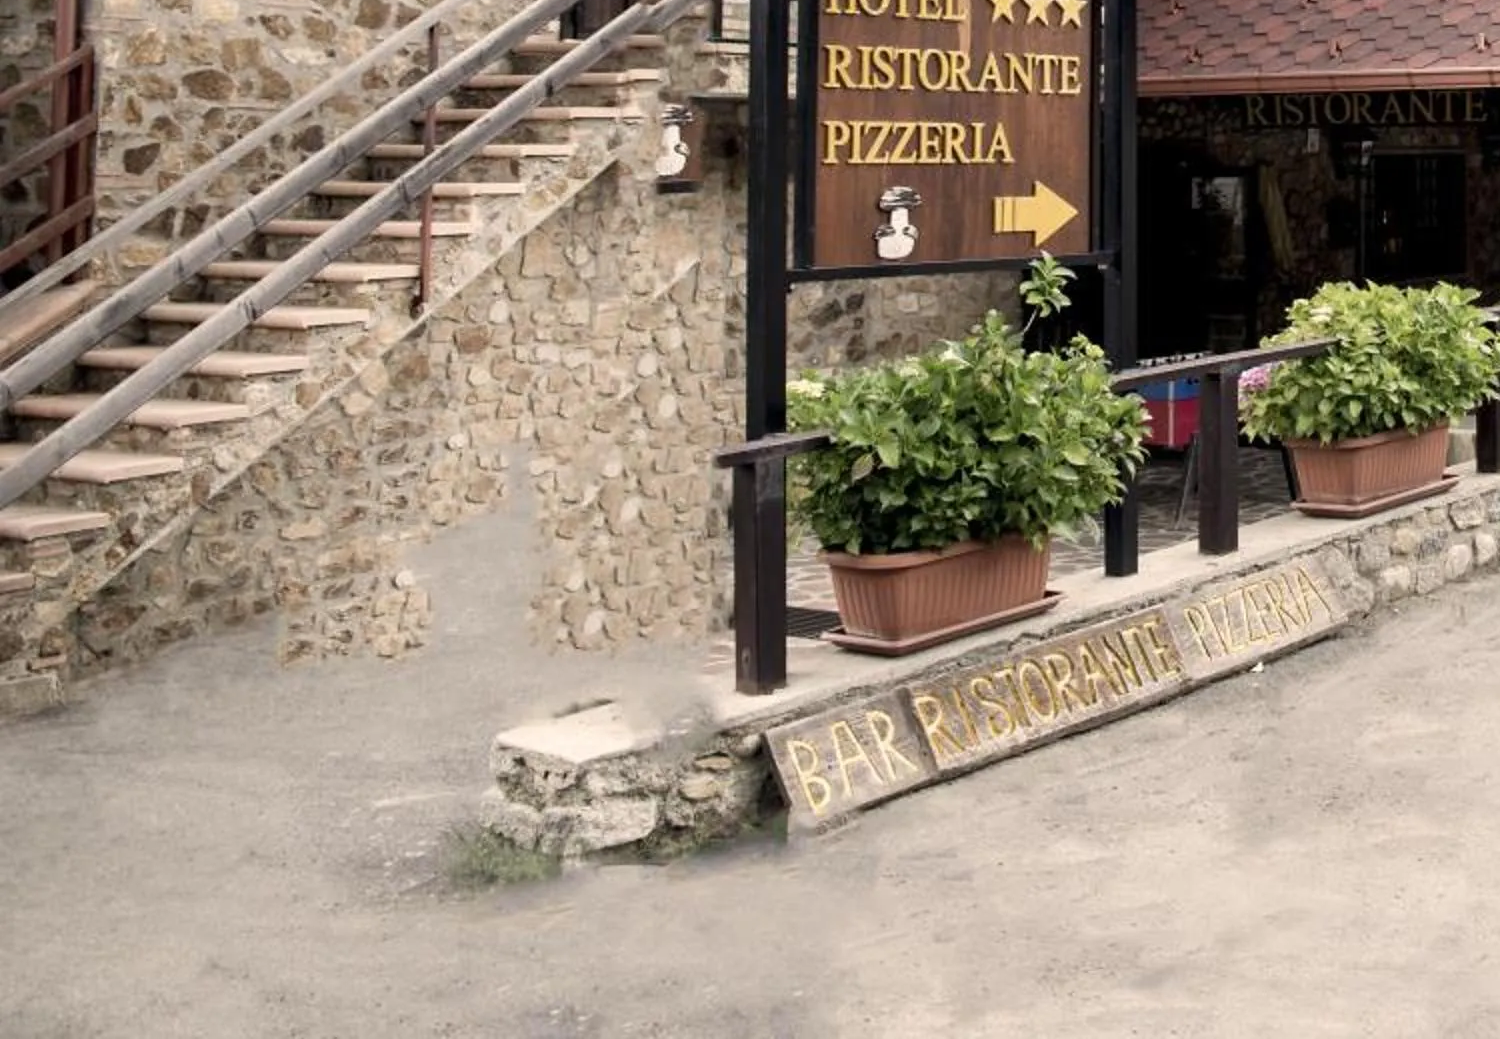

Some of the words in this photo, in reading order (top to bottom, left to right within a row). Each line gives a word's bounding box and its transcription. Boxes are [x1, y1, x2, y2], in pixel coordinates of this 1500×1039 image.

[823, 44, 1082, 95] RISTORANTE
[1245, 89, 1489, 125] RISTORANTE
[822, 119, 1016, 164] PIZZERIA
[787, 709, 918, 815] BAR
[911, 615, 1186, 757] RISTORANTE
[1183, 565, 1335, 661] PIZZERIA
